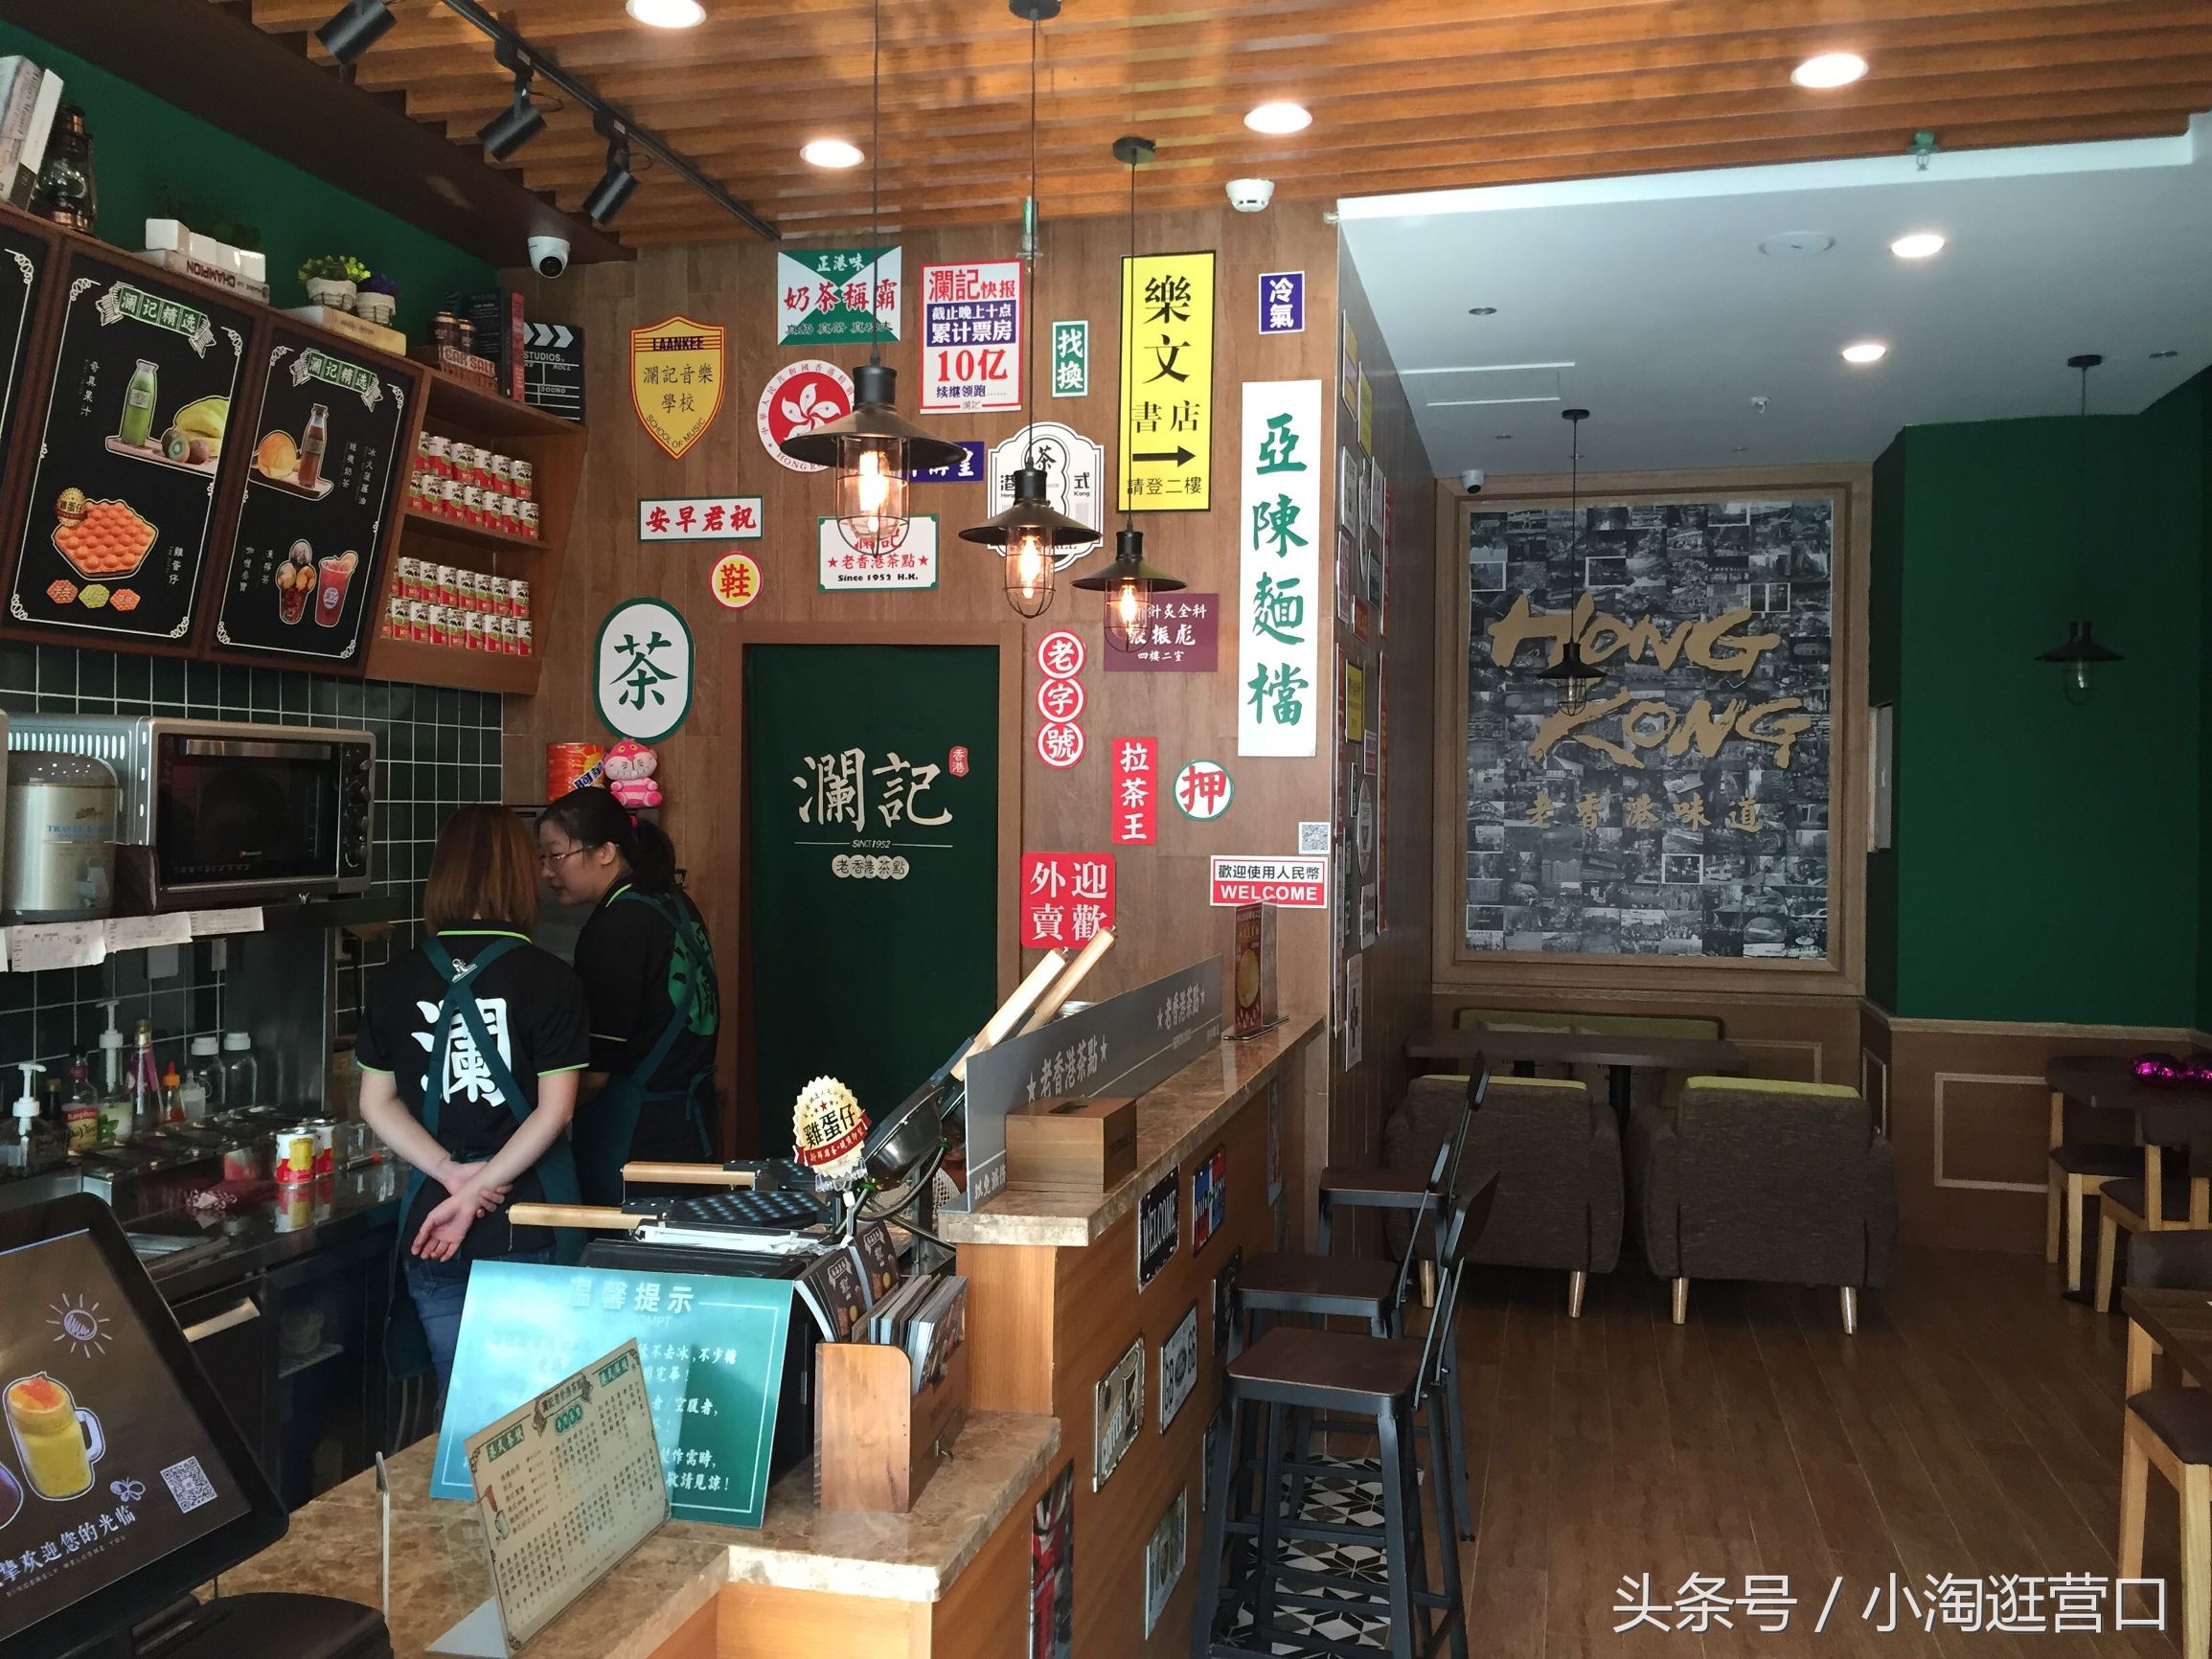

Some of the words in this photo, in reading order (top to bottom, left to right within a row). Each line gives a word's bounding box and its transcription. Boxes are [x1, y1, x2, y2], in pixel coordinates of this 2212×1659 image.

[817, 253, 864, 272] 正港味
[784, 278, 897, 312] 奶茶稱霸
[1269, 277, 1294, 329] 冷氣
[932, 304, 1012, 321] 截止晚上十点
[652, 336, 705, 352] LAANKEE
[931, 320, 1013, 345] 累计票房
[643, 363, 713, 385] 瀾記音樂
[938, 349, 1008, 382] 10亿
[1058, 329, 1083, 390] 找換
[661, 393, 696, 414] 學校
[1131, 400, 1200, 434] 書店
[647, 415, 673, 444] SCHOOL
[683, 417, 706, 443] MUSIC
[1036, 444, 1057, 472] 茶
[1074, 472, 1090, 489] 式
[1127, 476, 1202, 495] 請登二樓
[842, 554, 915, 570] 老香港茶點
[1247, 413, 1309, 726] 亞陳麵檔
[719, 563, 751, 598] 鞋
[1488, 590, 1781, 678] HONG
[609, 631, 679, 711] 茶
[1046, 640, 1076, 761] 老字號
[1529, 687, 1812, 769] KONG
[792, 747, 954, 832] 瀾記
[1120, 742, 1150, 841] 拉茶王
[1179, 765, 1227, 816] 押
[1526, 793, 1763, 833] 老香港味道
[835, 859, 906, 875] 老香港茶點
[1218, 865, 1320, 880] 歡迎使用人民幣
[1220, 885, 1318, 901] WELCOME
[1040, 1034, 1099, 1097] 老香港茶點
[803, 1103, 855, 1148] 雞蛋仔
[0, 1505, 136, 1587] 挚欢迎您的光临
